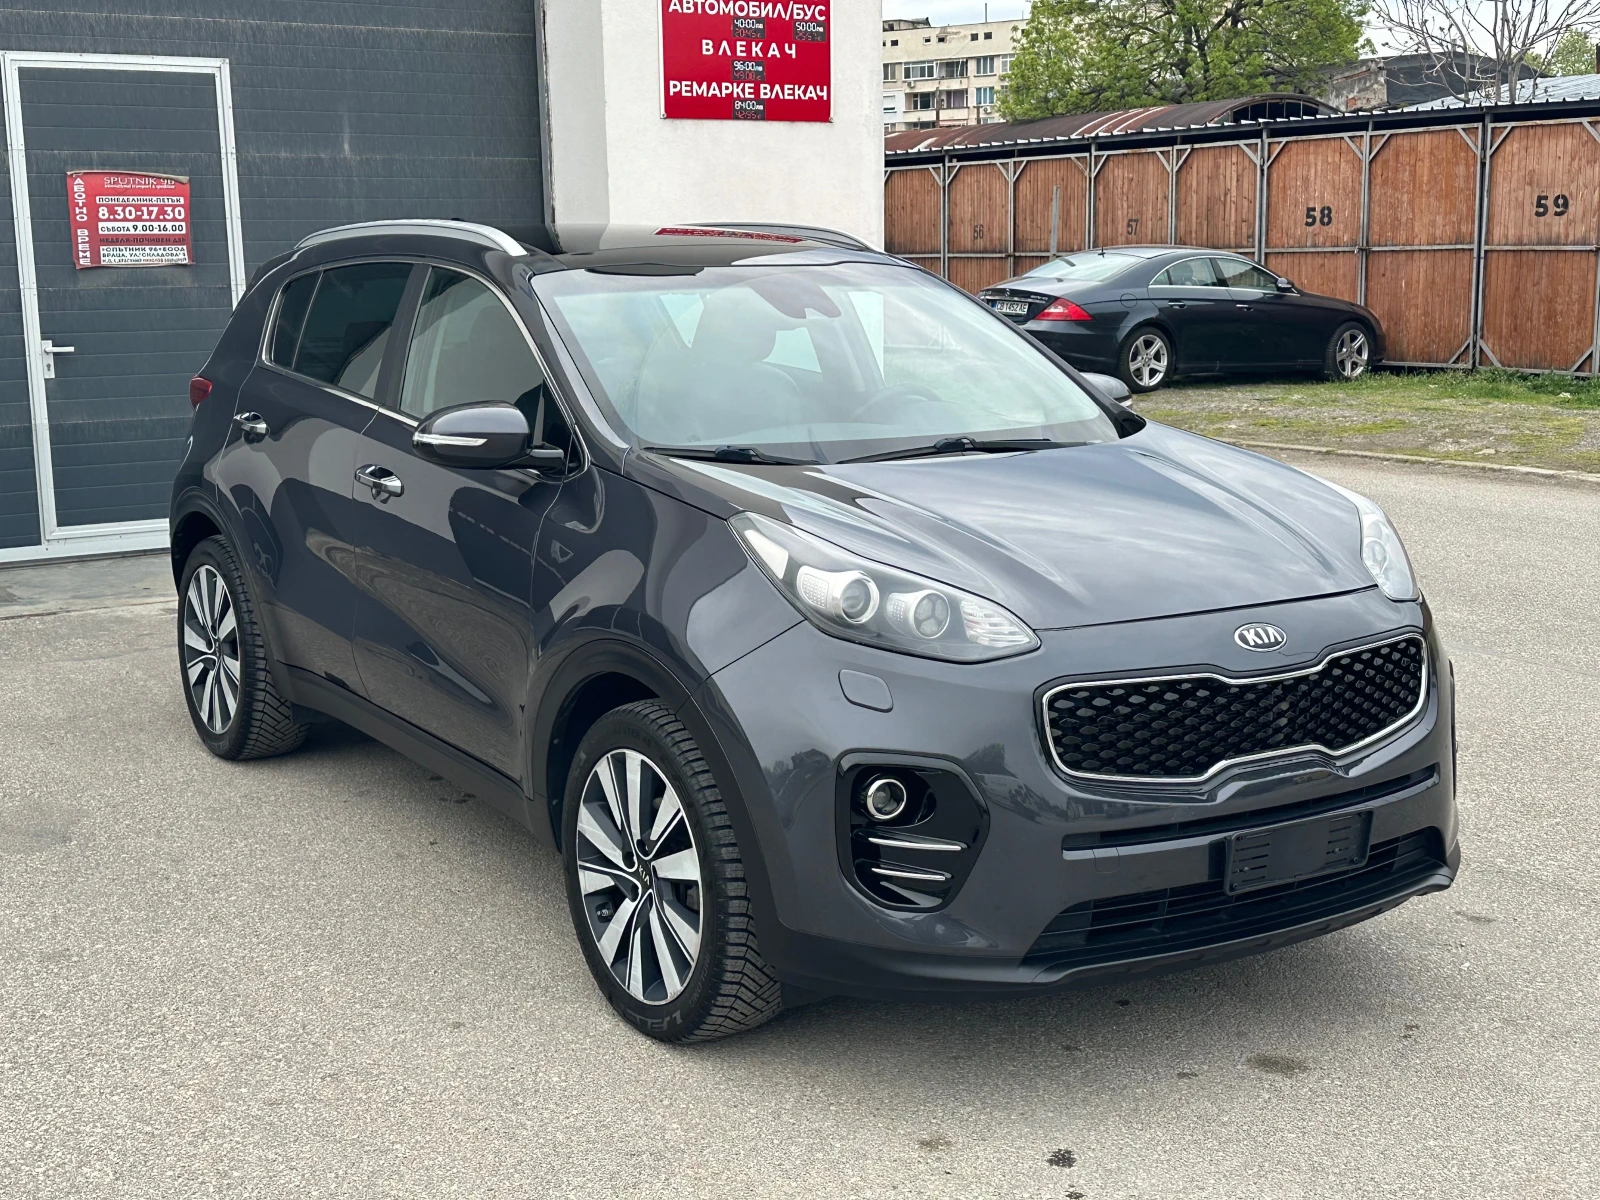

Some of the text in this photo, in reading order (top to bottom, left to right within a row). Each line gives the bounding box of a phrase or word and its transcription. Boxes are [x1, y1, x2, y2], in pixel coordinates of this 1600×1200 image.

[668, 0, 826, 20] АВТОМОБИЛ/БУС
[701, 39, 796, 59] ВЛЕКАЧ
[669, 80, 828, 100] РЕМАРКЕ ВЛЕКАЧ
[103, 176, 157, 185] SPUTNIK
[98, 206, 185, 219] 8.30-17.30
[1534, 194, 1569, 217] 59
[1304, 205, 1333, 227] 58
[132, 224, 184, 233] 9.00-16.00
[973, 224, 984, 240] 56
[1127, 219, 1139, 235] 57
[77, 229, 91, 265] ВРЕМЕ
[1242, 626, 1283, 646] KIA
[638, 865, 651, 886] KIA
